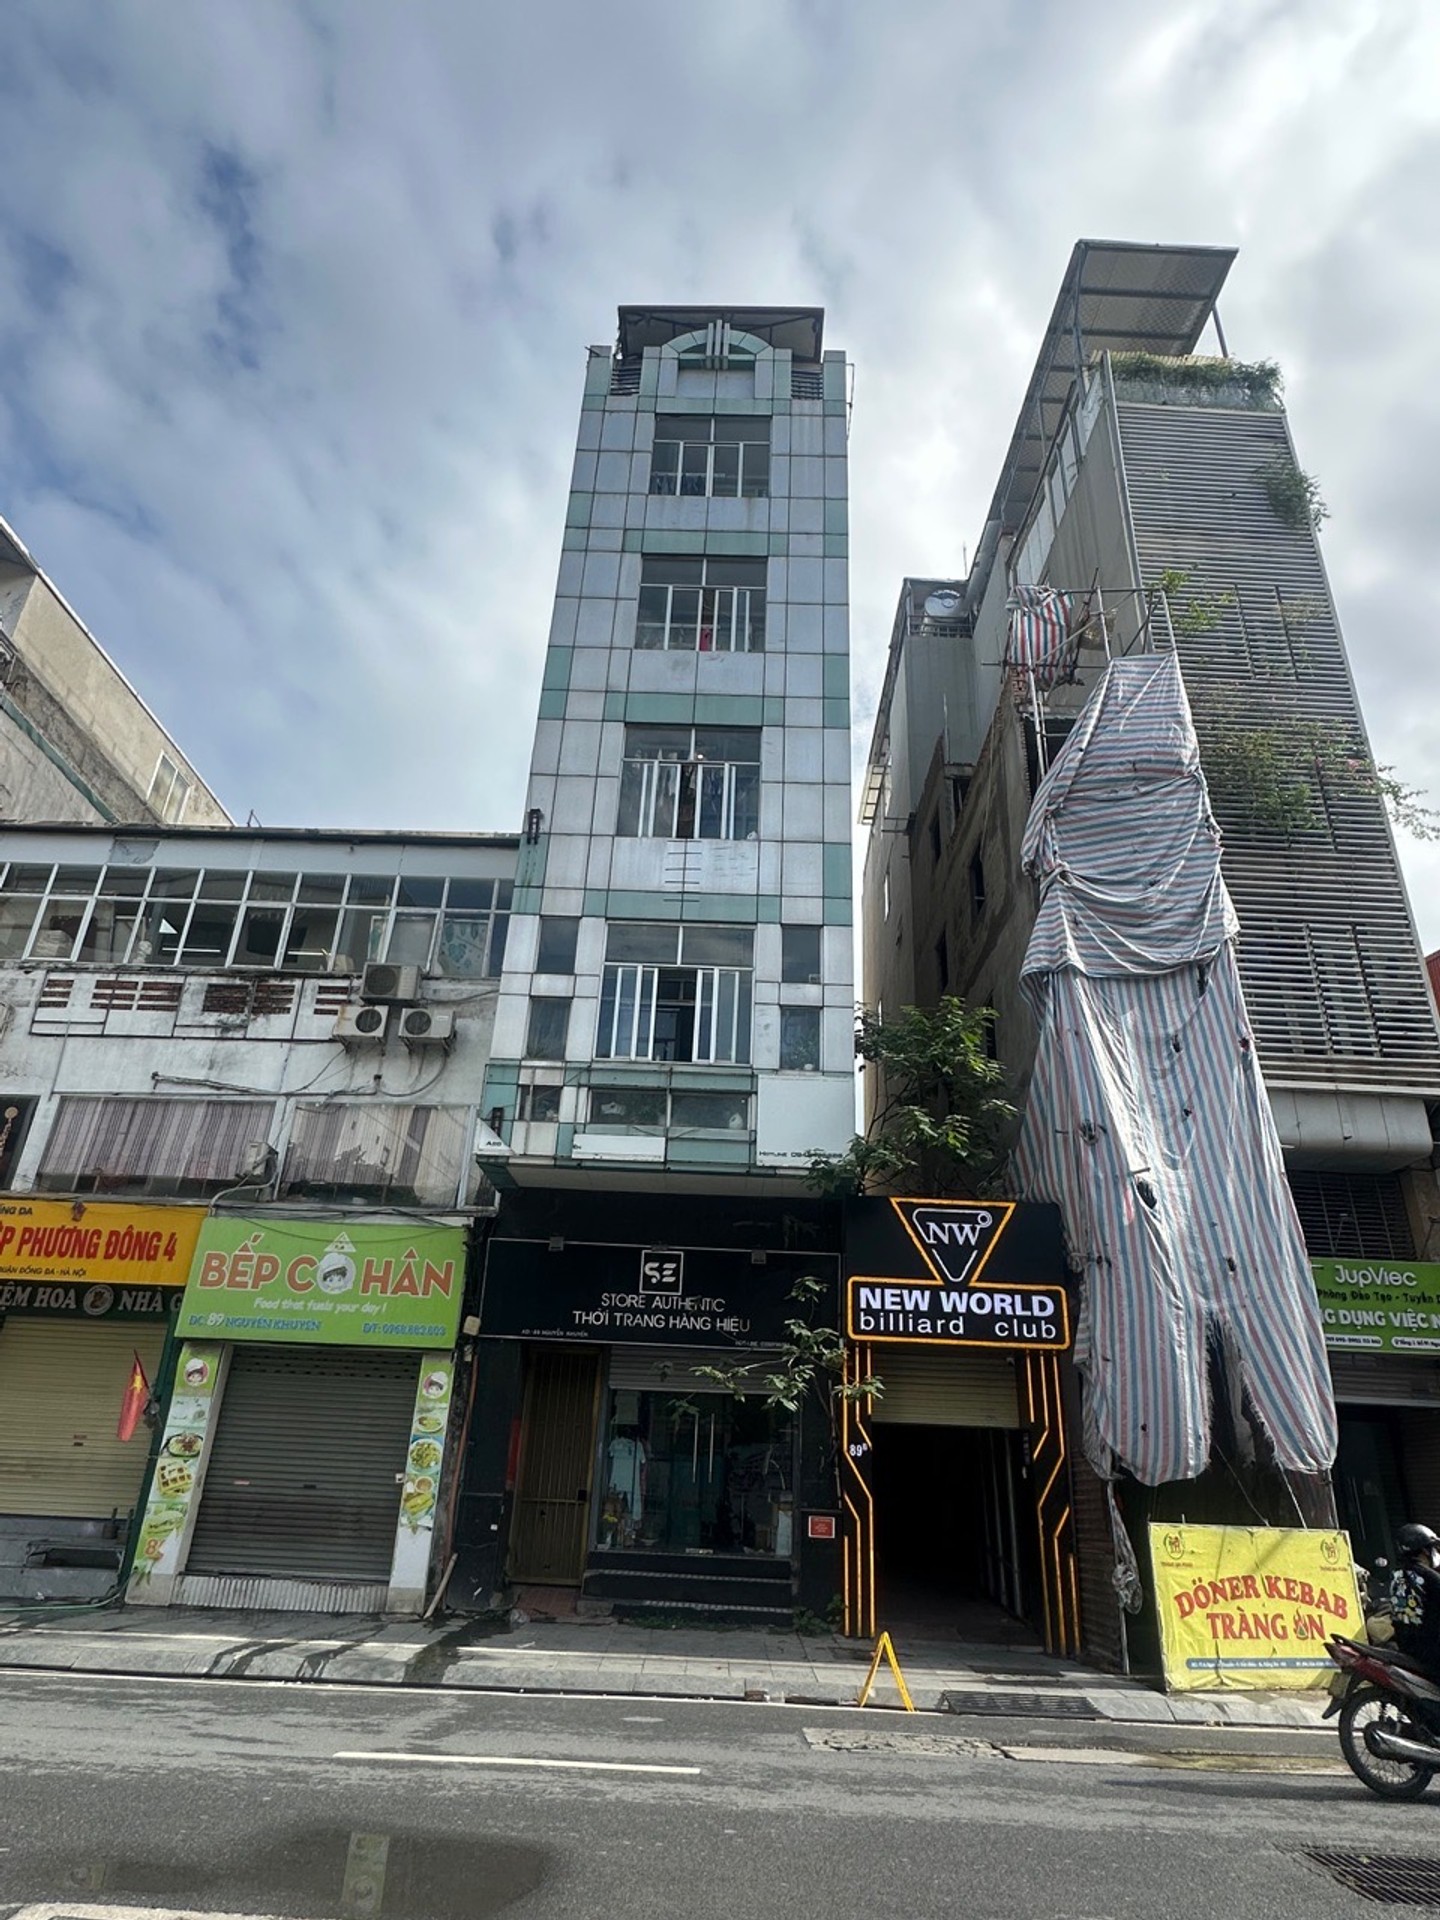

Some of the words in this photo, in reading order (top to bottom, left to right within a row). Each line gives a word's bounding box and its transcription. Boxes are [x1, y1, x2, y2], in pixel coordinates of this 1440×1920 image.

[104, 1224, 163, 1261] ĐÔNG
[163, 1231, 178, 1262] 4
[926, 1222, 980, 1246] NW
[199, 1232, 281, 1290] BẾP
[359, 1246, 455, 1300] HÂN
[0, 1281, 33, 1311] ỆM
[33, 1286, 77, 1309] HOA
[118, 1286, 163, 1312] NHÀ
[601, 1292, 647, 1309] STORE
[651, 1295, 726, 1313] AUTHENTIC
[859, 1287, 931, 1311] NEW
[939, 1291, 1055, 1316] WORLD
[206, 1312, 224, 1326] 89
[614, 1312, 666, 1328] TRANG
[669, 1312, 711, 1331] HÀNG
[716, 1315, 750, 1336] HIỆU
[860, 1312, 964, 1335] billiard
[995, 1319, 1056, 1338] club
[1338, 1309, 1386, 1330] DỤNG
[1389, 1308, 1429, 1332] VIỆC
[1173, 1576, 1261, 1619] DÖNER
[1264, 1574, 1348, 1620] KEBAB
[1206, 1606, 1289, 1641] TRÀNG
